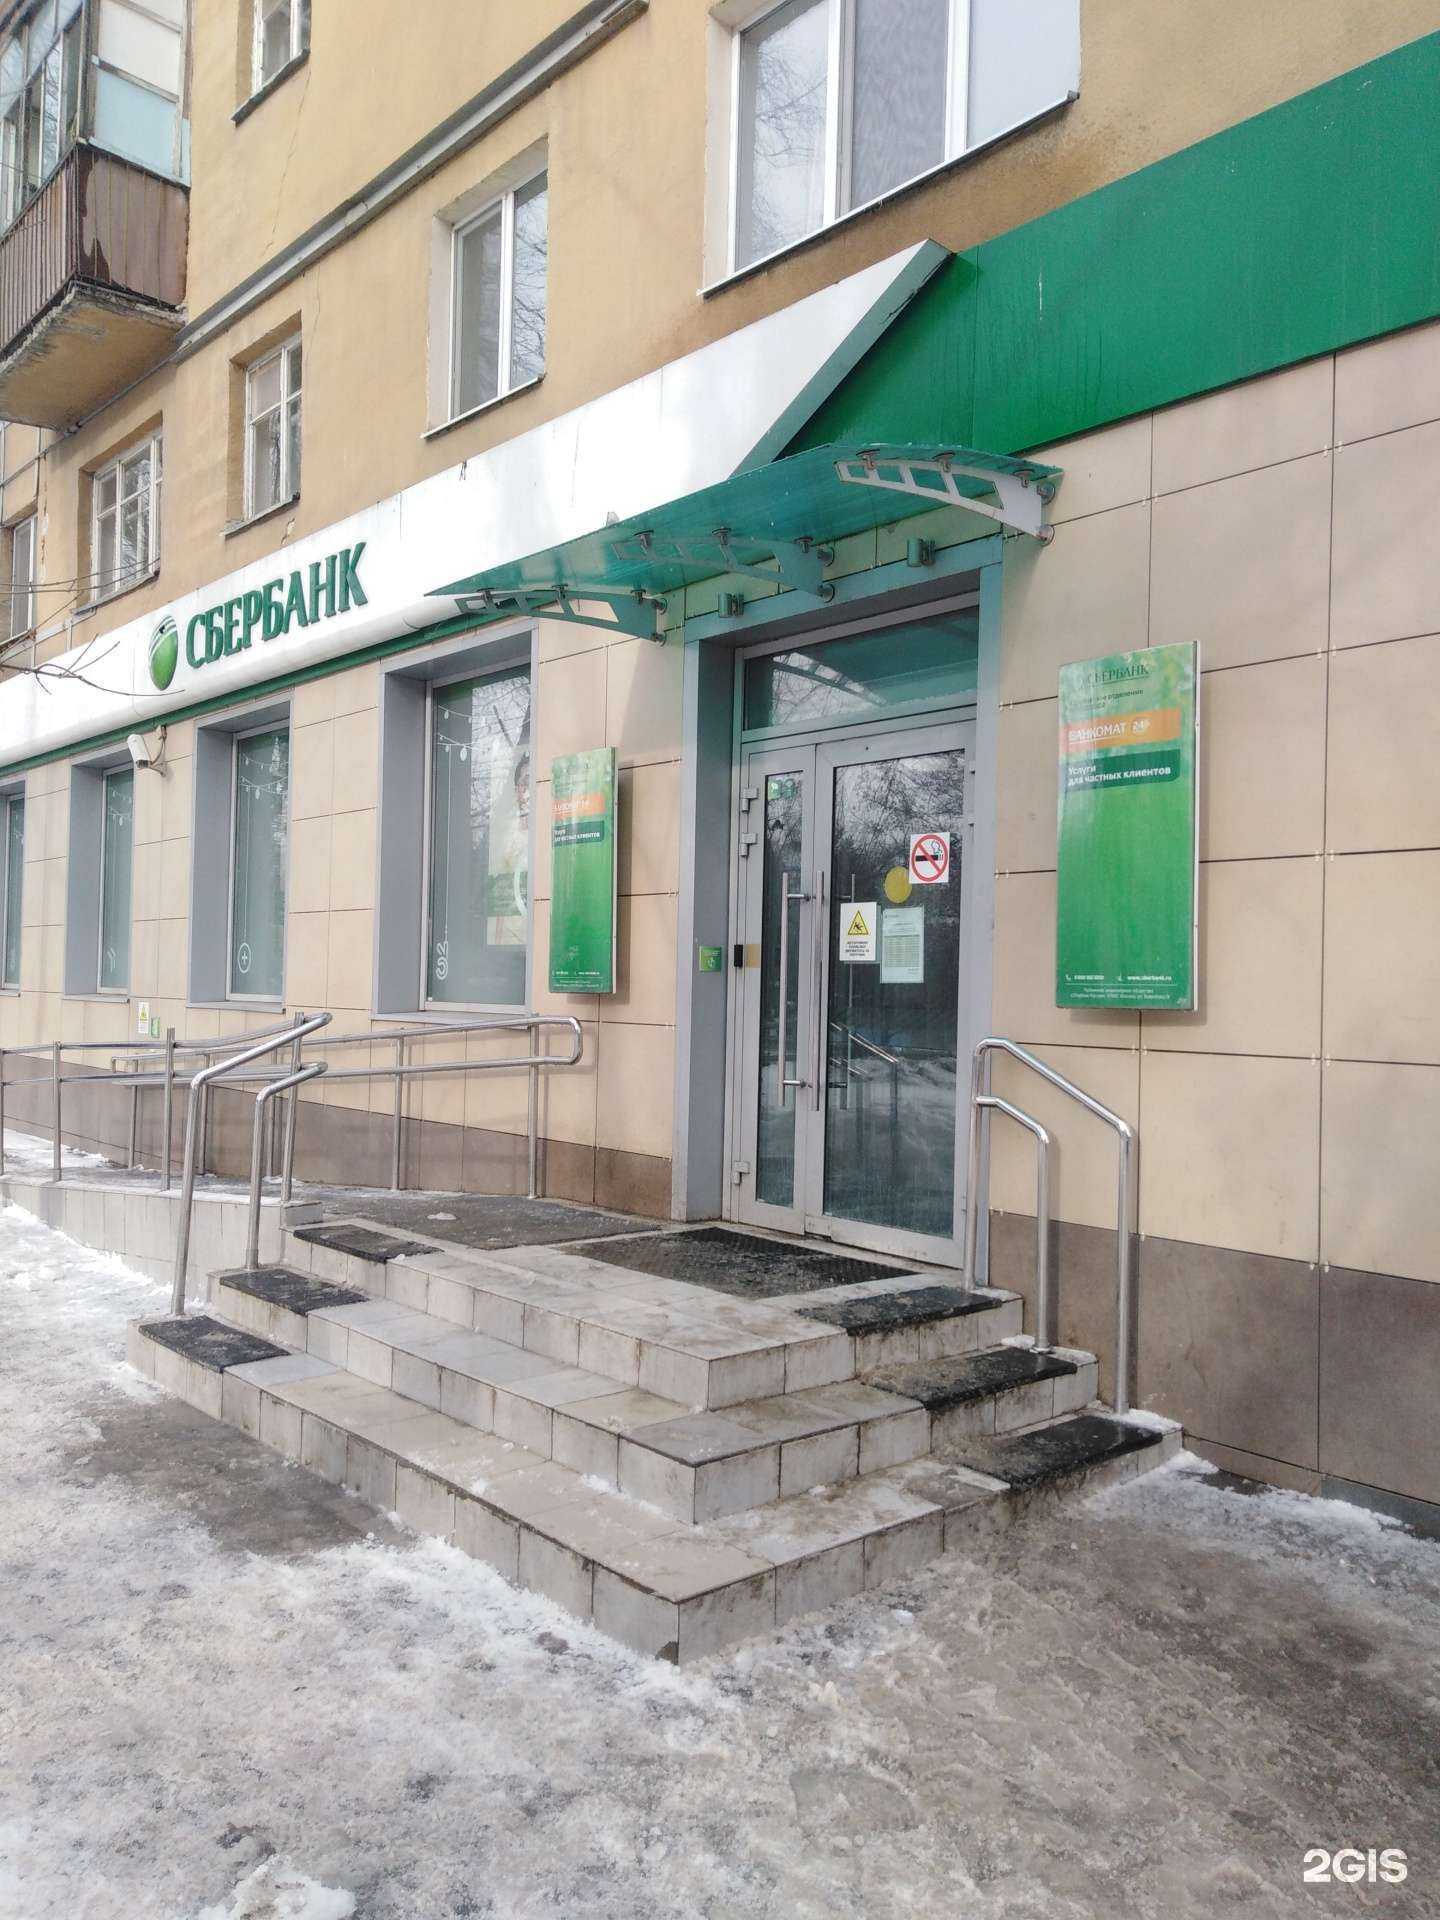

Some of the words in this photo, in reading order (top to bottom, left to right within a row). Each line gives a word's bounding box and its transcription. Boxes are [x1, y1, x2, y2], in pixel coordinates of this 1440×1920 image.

[186, 542, 368, 669] СБЕРБАНК
[1068, 766, 1096, 777] Услуги
[1085, 773, 1122, 783] частных
[1123, 767, 1172, 778] клиентов
